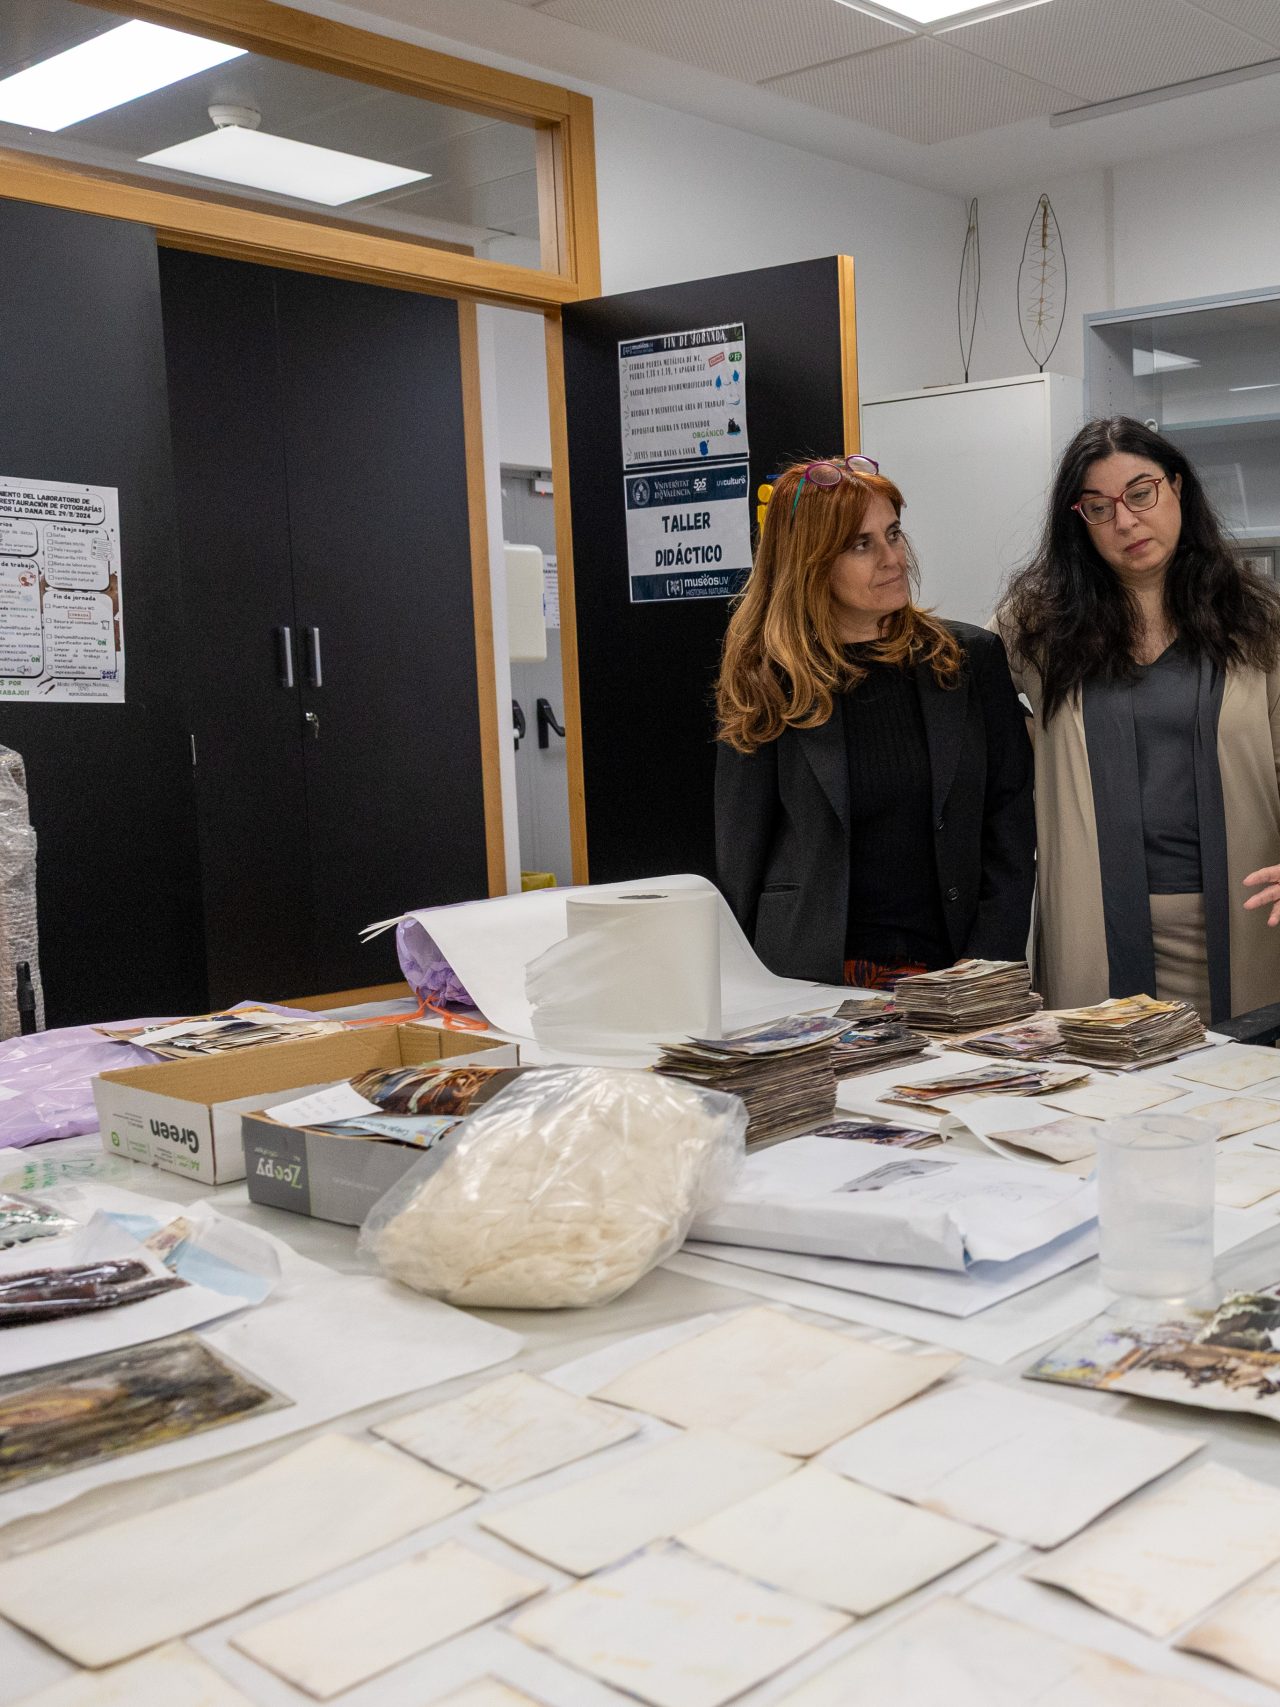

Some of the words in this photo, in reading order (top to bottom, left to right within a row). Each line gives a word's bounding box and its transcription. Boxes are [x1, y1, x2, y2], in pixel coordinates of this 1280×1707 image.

[664, 337, 675, 349] FIN
[680, 336, 687, 346] DE
[692, 331, 726, 345] JORNADA
[692, 428, 724, 438] ORGÁNICO
[37, 495, 80, 504] LABORATORIO
[60, 503, 102, 513] FOTOGRAFÍAS
[53, 525, 76, 533] Trabajo
[662, 512, 710, 533] TALLER
[655, 542, 722, 567] DIDÁCTICO
[149, 1118, 200, 1154] Green
